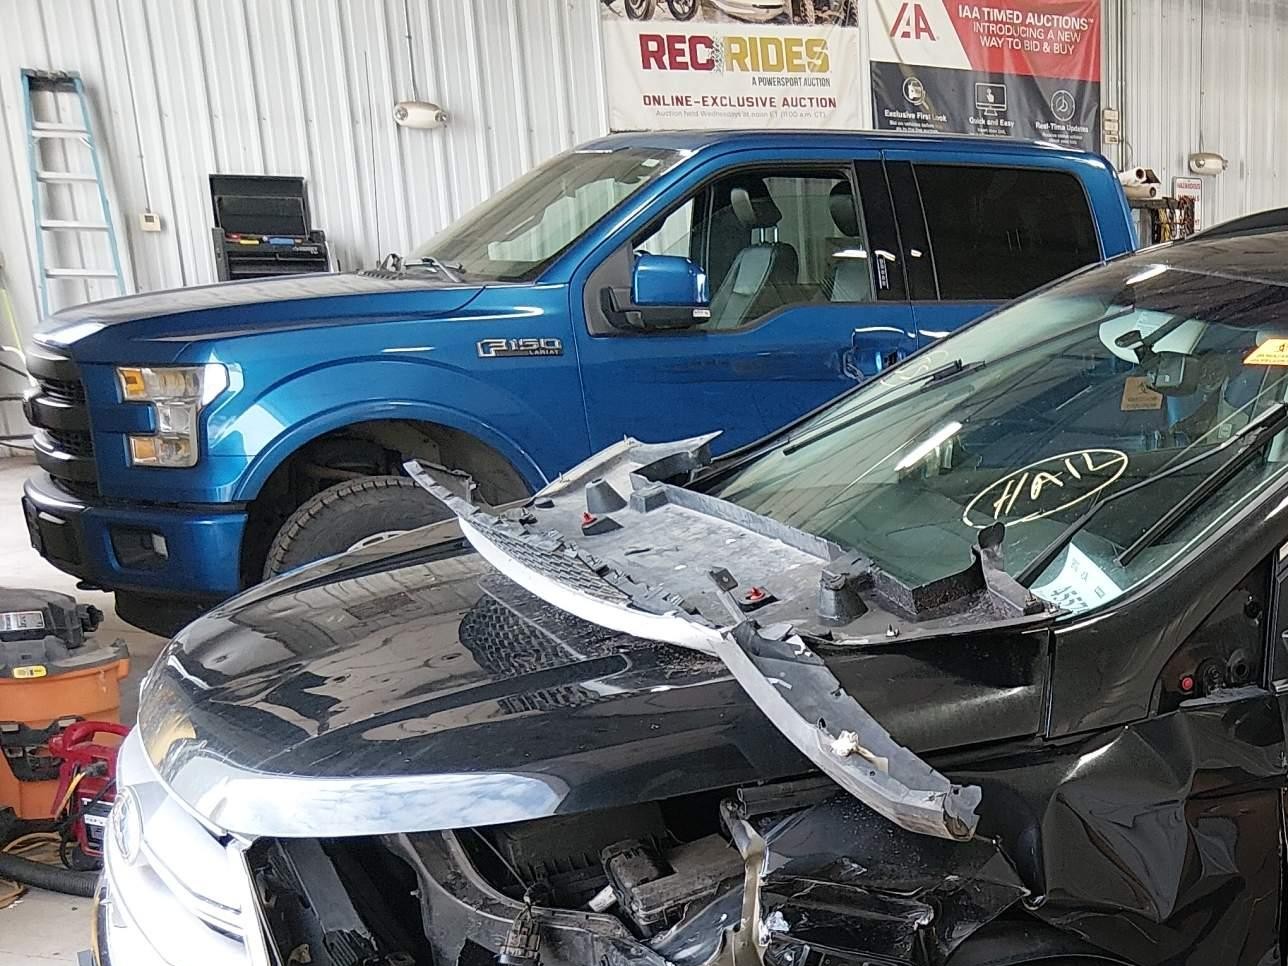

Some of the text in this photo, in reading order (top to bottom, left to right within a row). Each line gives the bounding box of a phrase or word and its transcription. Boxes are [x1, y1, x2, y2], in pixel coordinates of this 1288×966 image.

[959, 5, 980, 20] IAA
[982, 8, 1023, 24] TIMED
[973, 22, 1081, 43] INTRODUCING A NEW
[639, 33, 831, 73] REC RIDES
[980, 36, 1075, 55] WAY TO BID & BUY
[752, 77, 831, 87] A POWERSPORT AUCTION
[643, 94, 837, 108] ONLINE-EXCLUSIVE AUCTION
[994, 452, 1125, 520] HAIL
